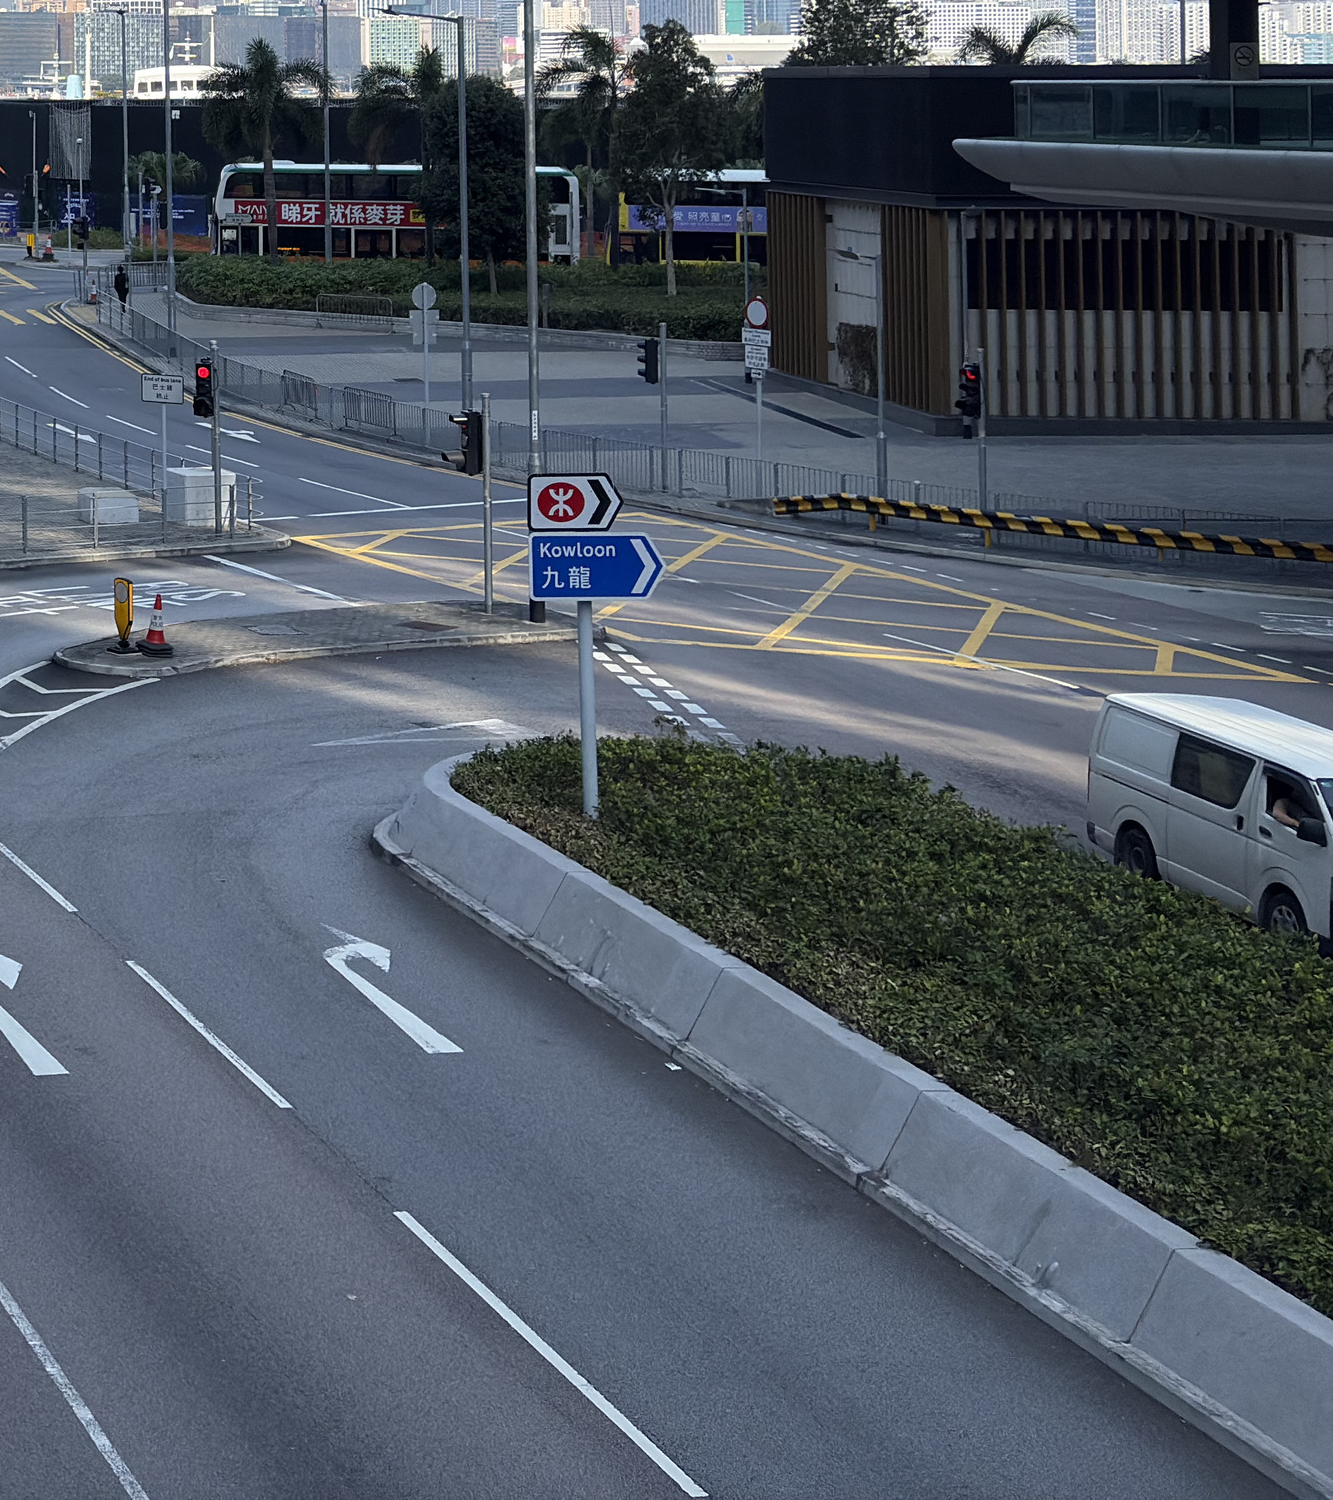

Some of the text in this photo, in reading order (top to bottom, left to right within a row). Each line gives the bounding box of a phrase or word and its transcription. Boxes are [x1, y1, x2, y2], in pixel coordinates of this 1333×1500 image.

[282, 204, 321, 224] 睇牙
[330, 204, 405, 224] 就係麥芽
[540, 542, 616, 558] Kowloon
[542, 566, 592, 589] 九龍
